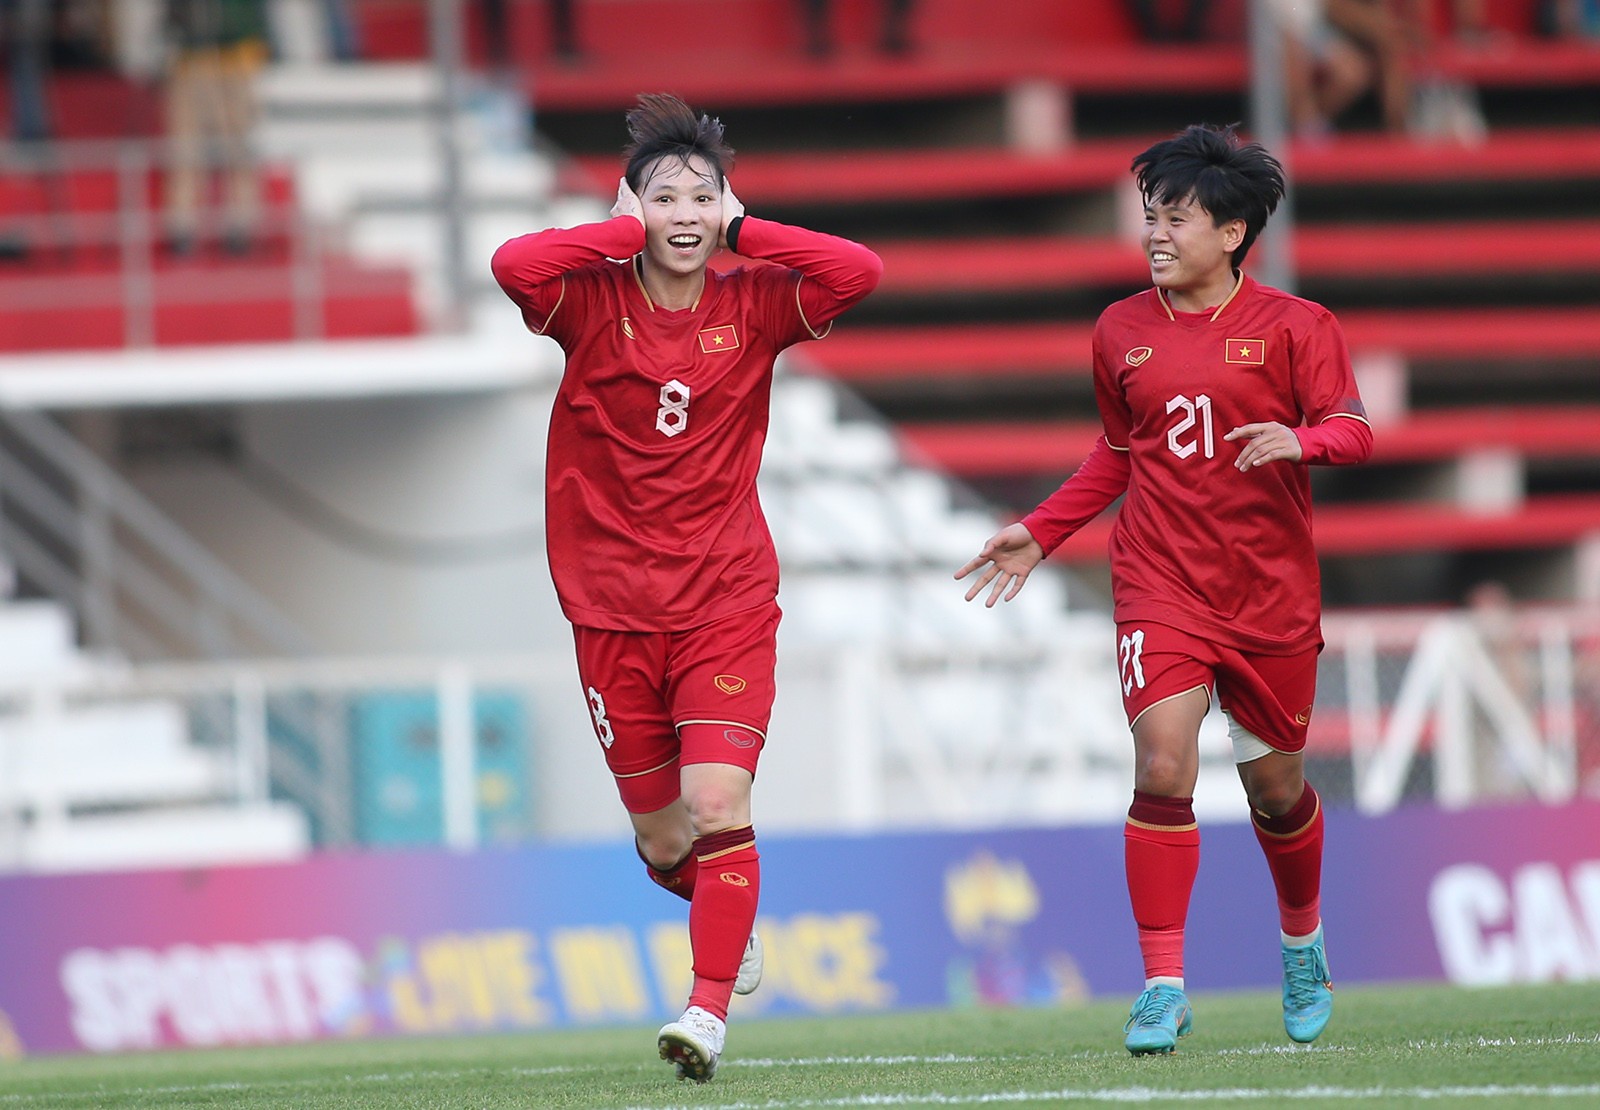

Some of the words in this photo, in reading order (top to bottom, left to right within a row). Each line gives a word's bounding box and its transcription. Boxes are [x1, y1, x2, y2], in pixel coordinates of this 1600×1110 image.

[655, 379, 691, 437] 8
[1165, 393, 1215, 460] 21
[1119, 629, 1146, 698] 21
[587, 685, 616, 750] 8
[60, 938, 364, 1053] SPORTS
